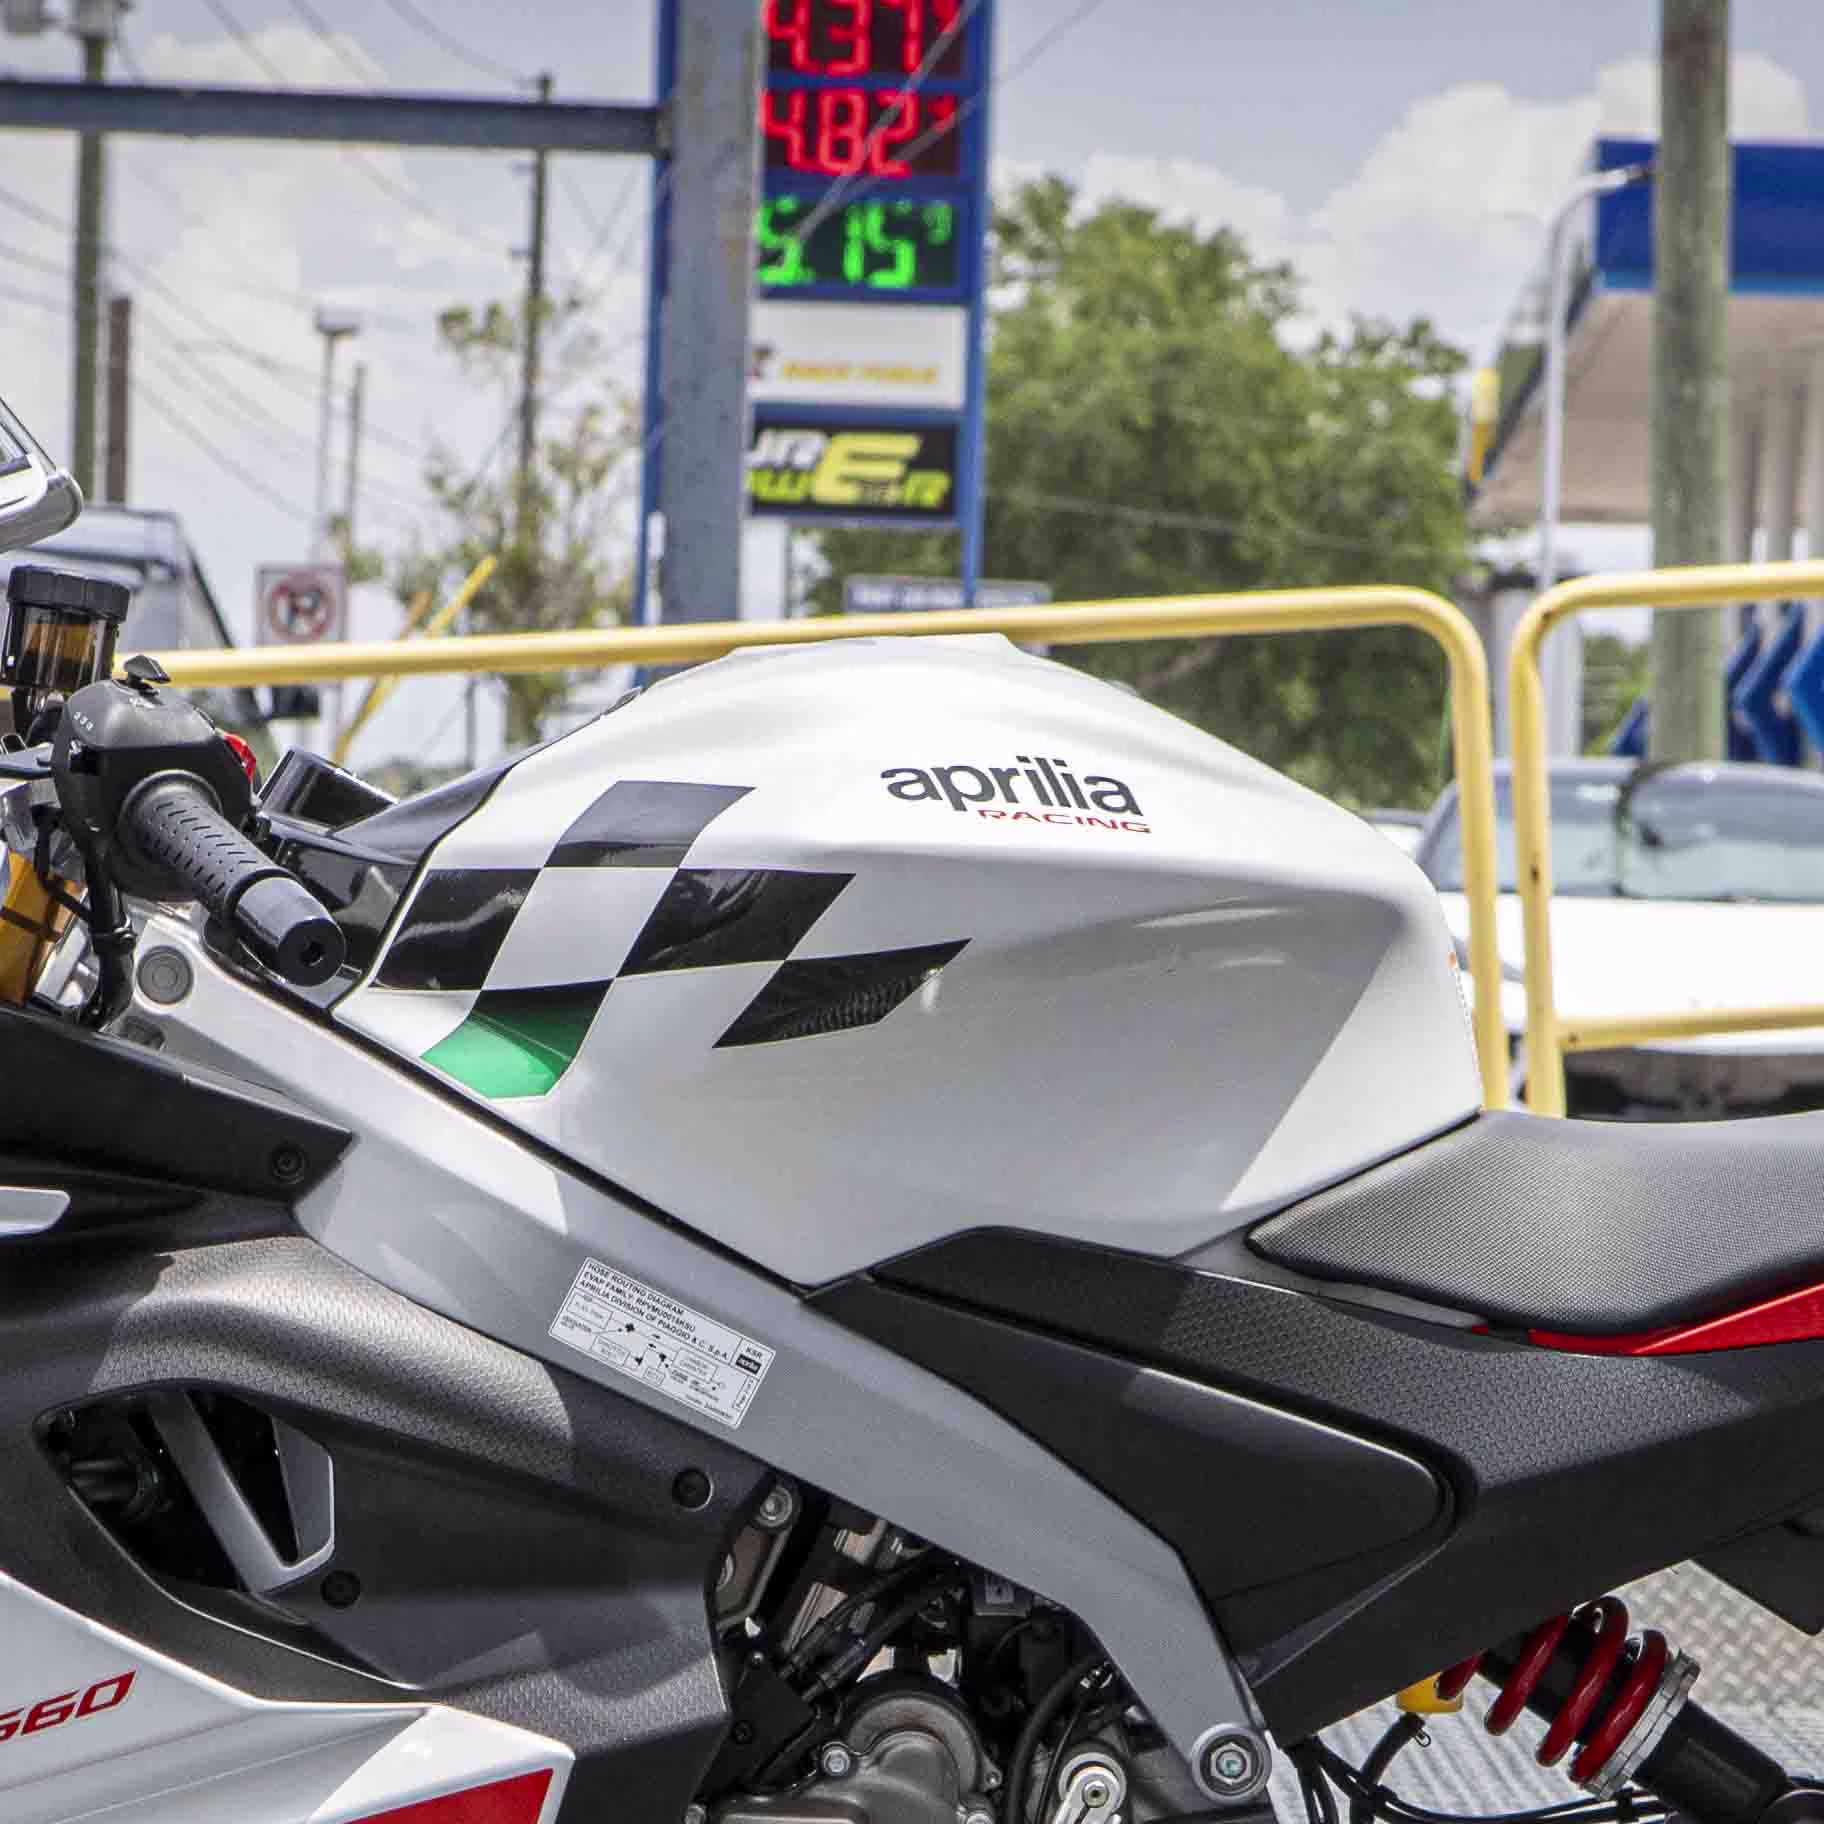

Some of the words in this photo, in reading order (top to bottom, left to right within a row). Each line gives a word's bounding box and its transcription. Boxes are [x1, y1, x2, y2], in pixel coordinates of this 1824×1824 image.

[880, 755, 1144, 817] aprilia
[977, 808, 1152, 834] RACING
[578, 1278, 610, 1299] APRILIA
[609, 1294, 645, 1317] DIVISION
[644, 1312, 656, 1323] OF
[656, 1318, 691, 1340] PIAGGIO
[587, 1263, 608, 1277] HOSE
[610, 1274, 647, 1297] ROUTING
[646, 1293, 684, 1316] DIAGRAM
